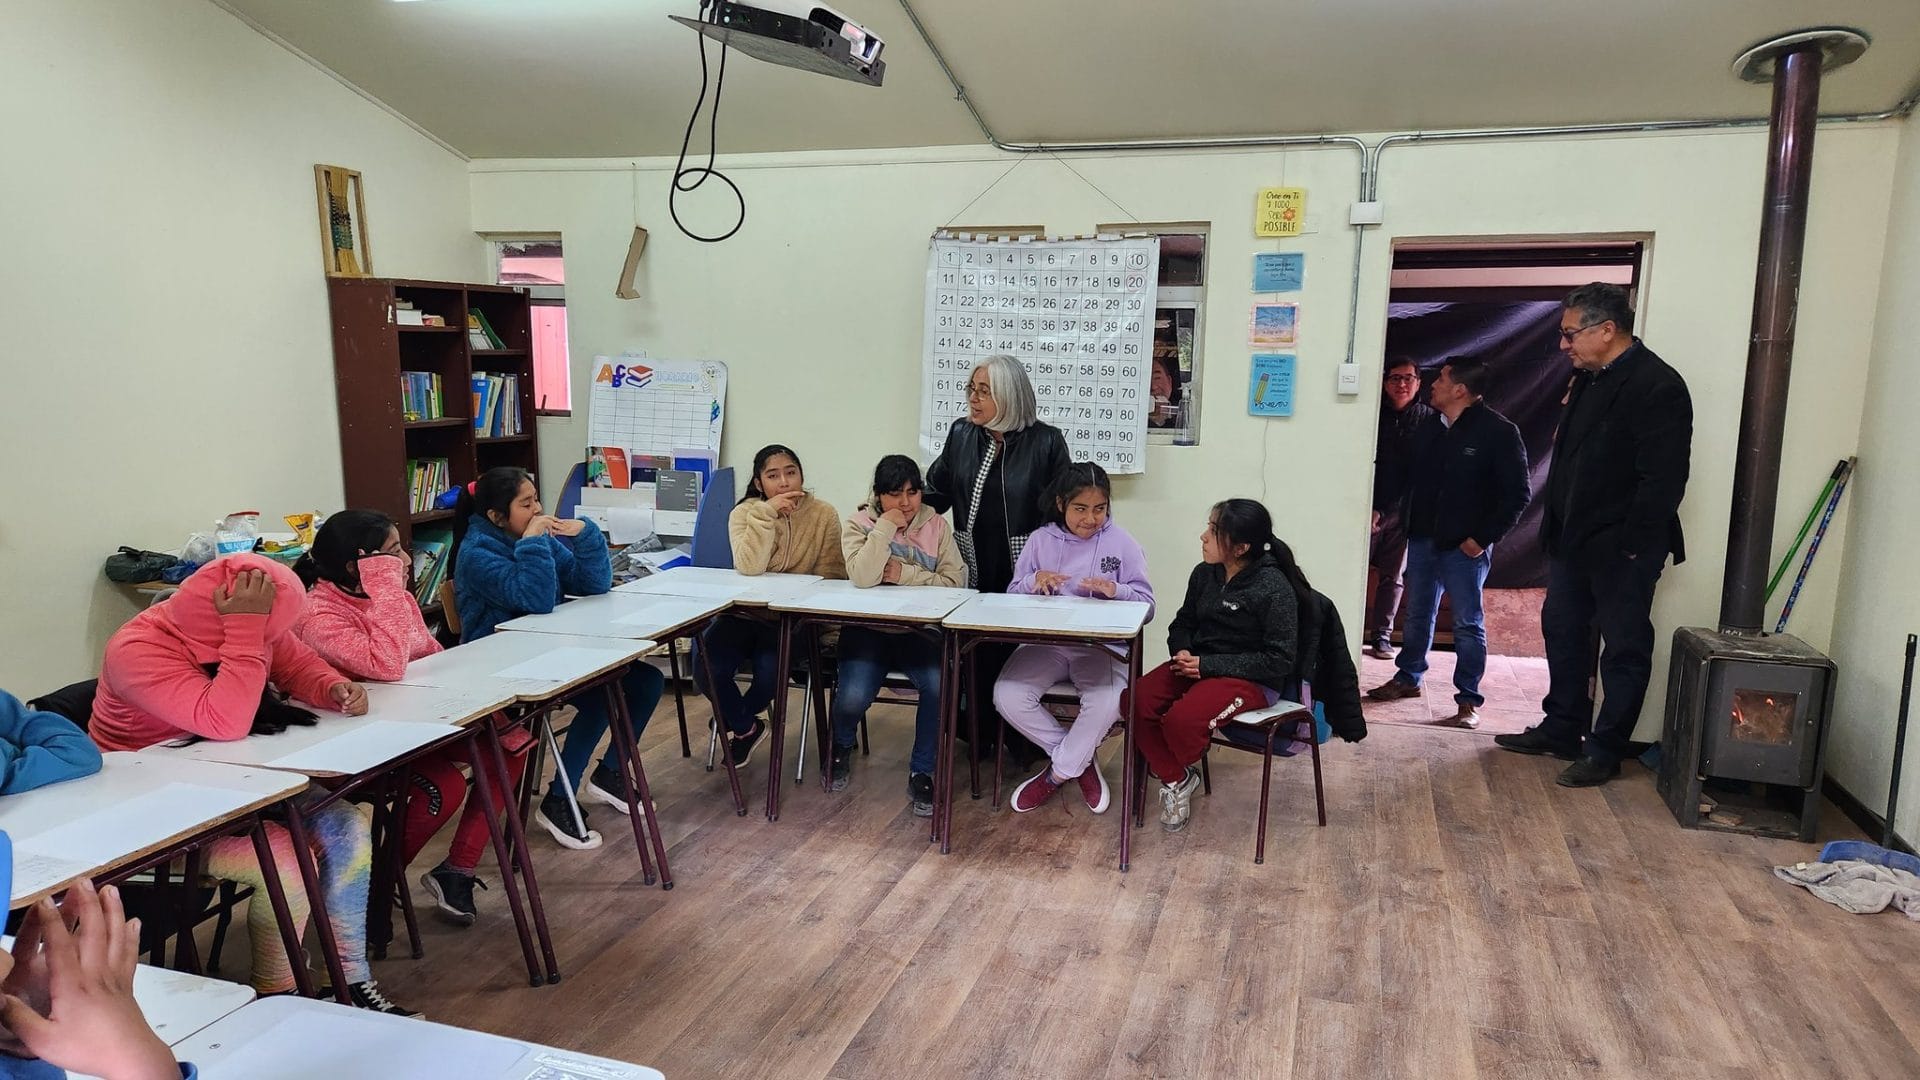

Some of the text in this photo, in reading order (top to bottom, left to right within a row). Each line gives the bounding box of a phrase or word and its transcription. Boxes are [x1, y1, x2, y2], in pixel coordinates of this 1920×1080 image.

[1266, 191, 1281, 200] Cree
[1264, 221, 1296, 232] POSIBLE
[948, 253, 1143, 265] 1 2 3 4 5 6 7 8 9 10
[944, 274, 1142, 287] 11 12 13 14 15 16 17 18 19 20
[941, 295, 1141, 310] 21 22 23 24 25 26 27 28 29 30
[940, 316, 1139, 332] 31 32 33 34 35 36 37 38 39 40
[939, 338, 1138, 354] 41 42 43 44 45 46 47 48 49 50
[938, 359, 950, 368] 51
[957, 360, 970, 369] 52
[1039, 364, 1053, 373] 56
[1060, 365, 1073, 374] 57
[1080, 365, 1093, 375] 58
[1101, 366, 1114, 376] 59
[1123, 367, 1137, 377] 60
[937, 380, 949, 390] 61
[1038, 385, 1051, 395] 66
[1059, 386, 1072, 395] 67
[1079, 387, 1093, 397] 68
[1100, 388, 1113, 398] 69
[1122, 388, 1135, 398] 70
[937, 401, 949, 410] 71
[1037, 406, 1050, 416] 76
[1058, 407, 1071, 417] 77
[1078, 408, 1091, 418] 78
[1099, 409, 1112, 419] 79
[1120, 410, 1134, 420] 80
[936, 422, 947, 431] 81
[1076, 430, 1090, 439] 88
[1097, 431, 1111, 440] 89
[1119, 432, 1133, 441] 90
[1075, 450, 1089, 460] 98
[1096, 451, 1110, 461] 99
[1116, 453, 1133, 463] 100
